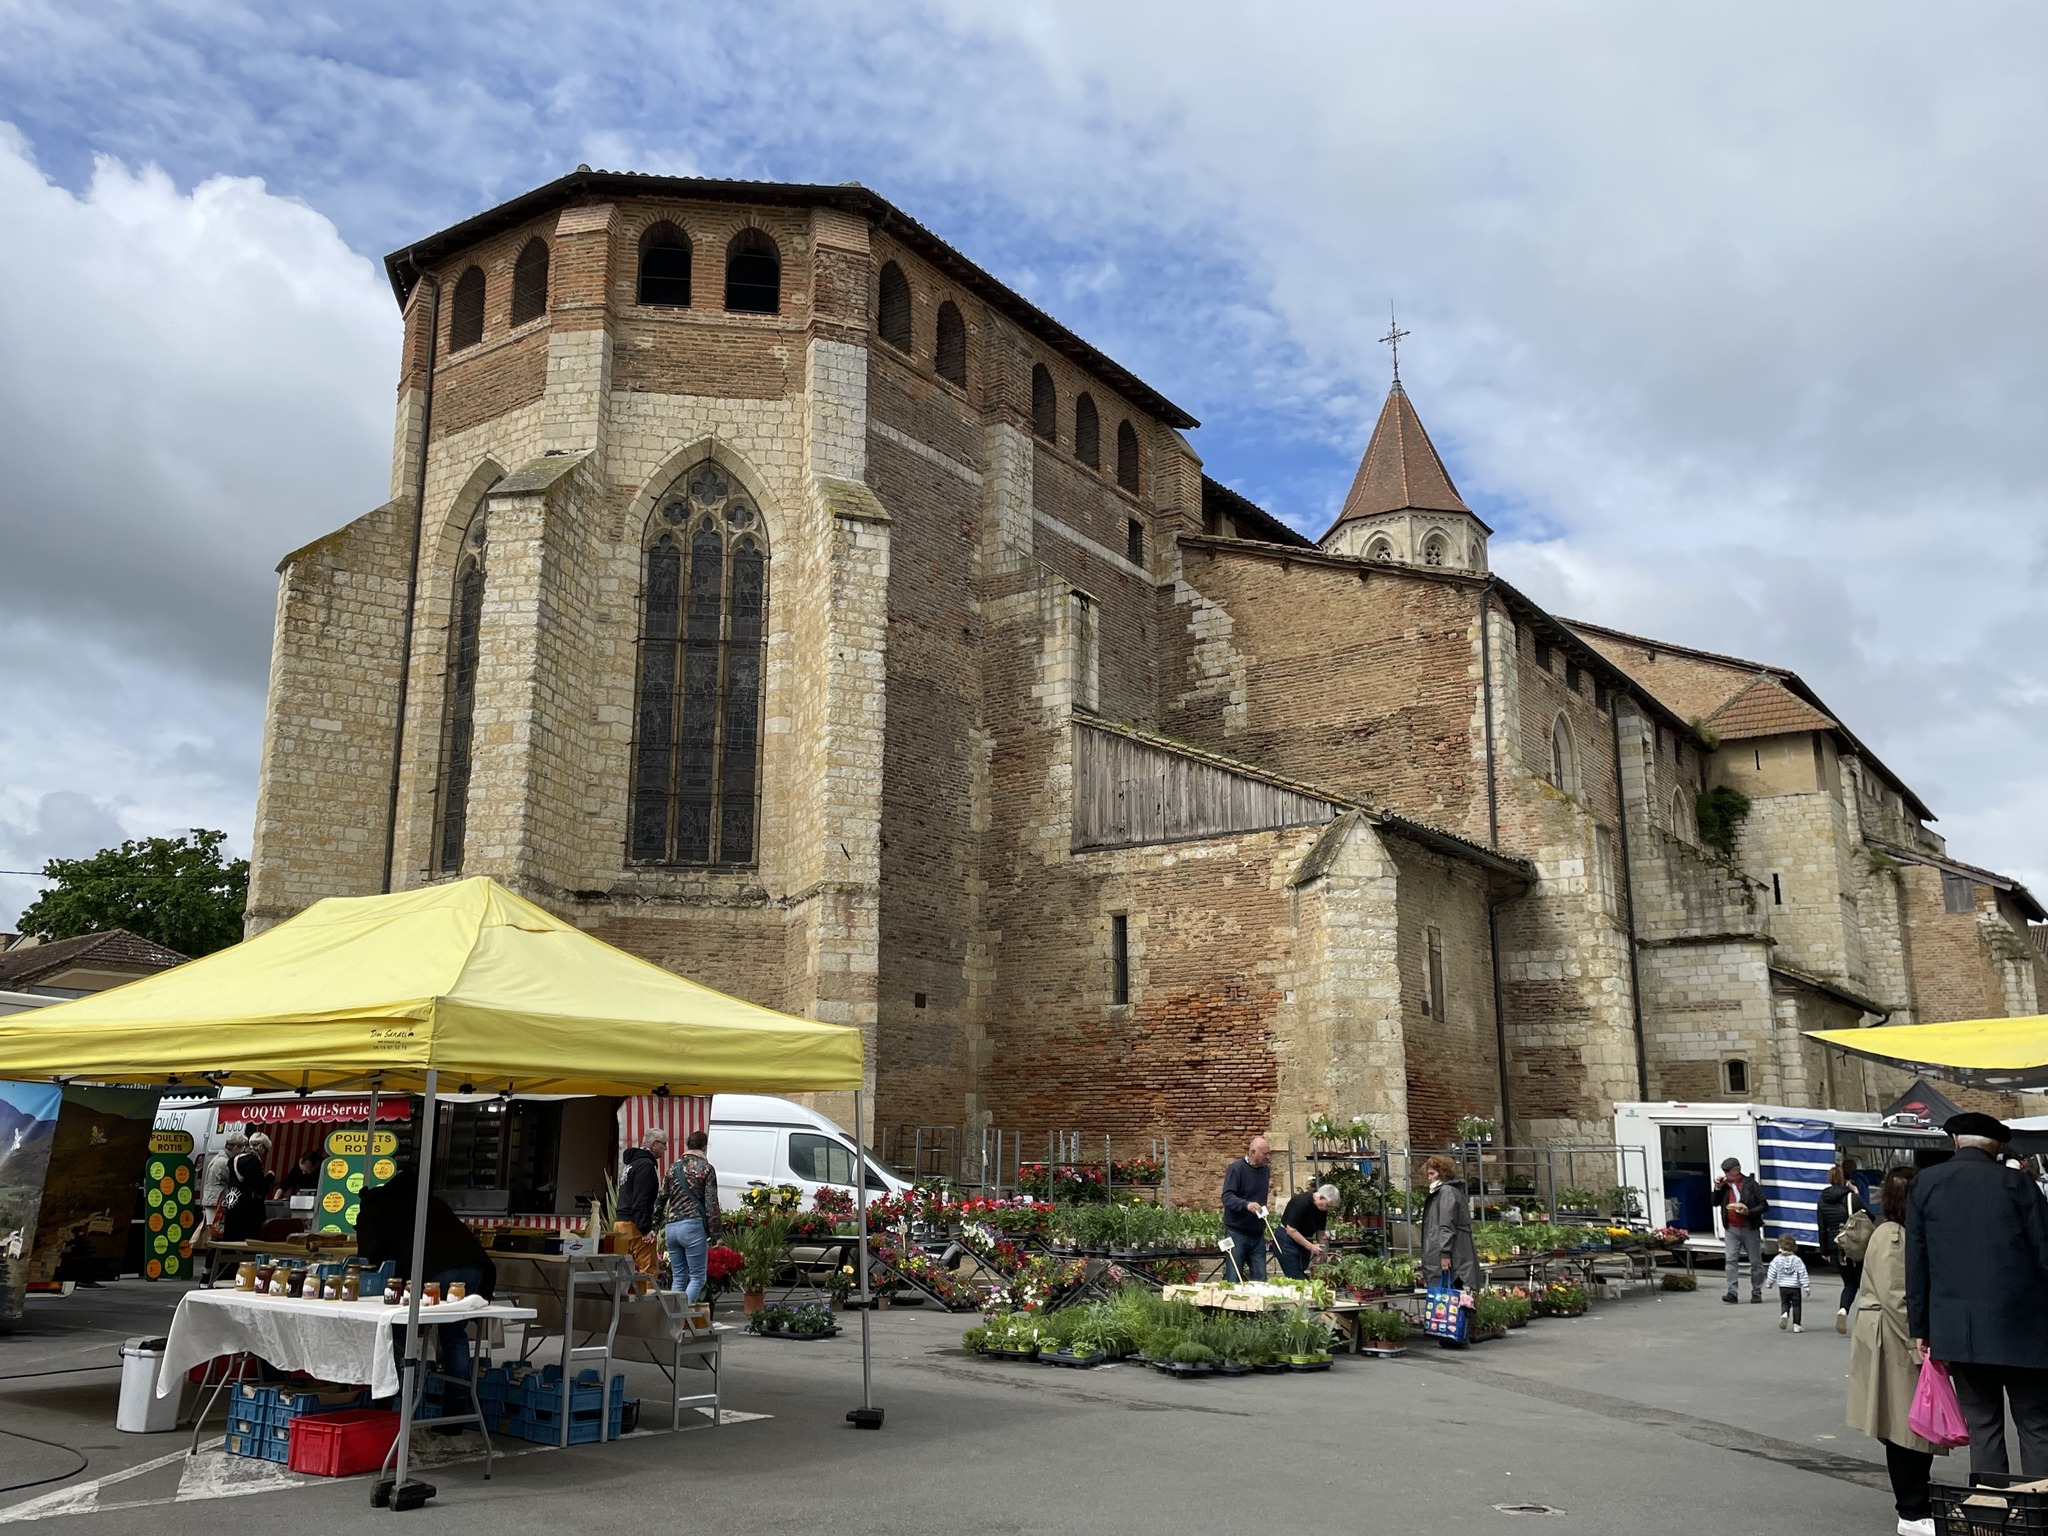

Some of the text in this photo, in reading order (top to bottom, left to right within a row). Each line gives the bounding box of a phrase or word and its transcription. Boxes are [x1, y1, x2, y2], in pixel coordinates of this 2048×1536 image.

[241, 1102, 384, 1119] COQ'IN "Rôti-Servic"
[154, 1111, 187, 1130] oulbil
[150, 1134, 189, 1142] POULETS
[157, 1143, 183, 1151] ROTIS
[344, 1145, 381, 1153] ROTS
